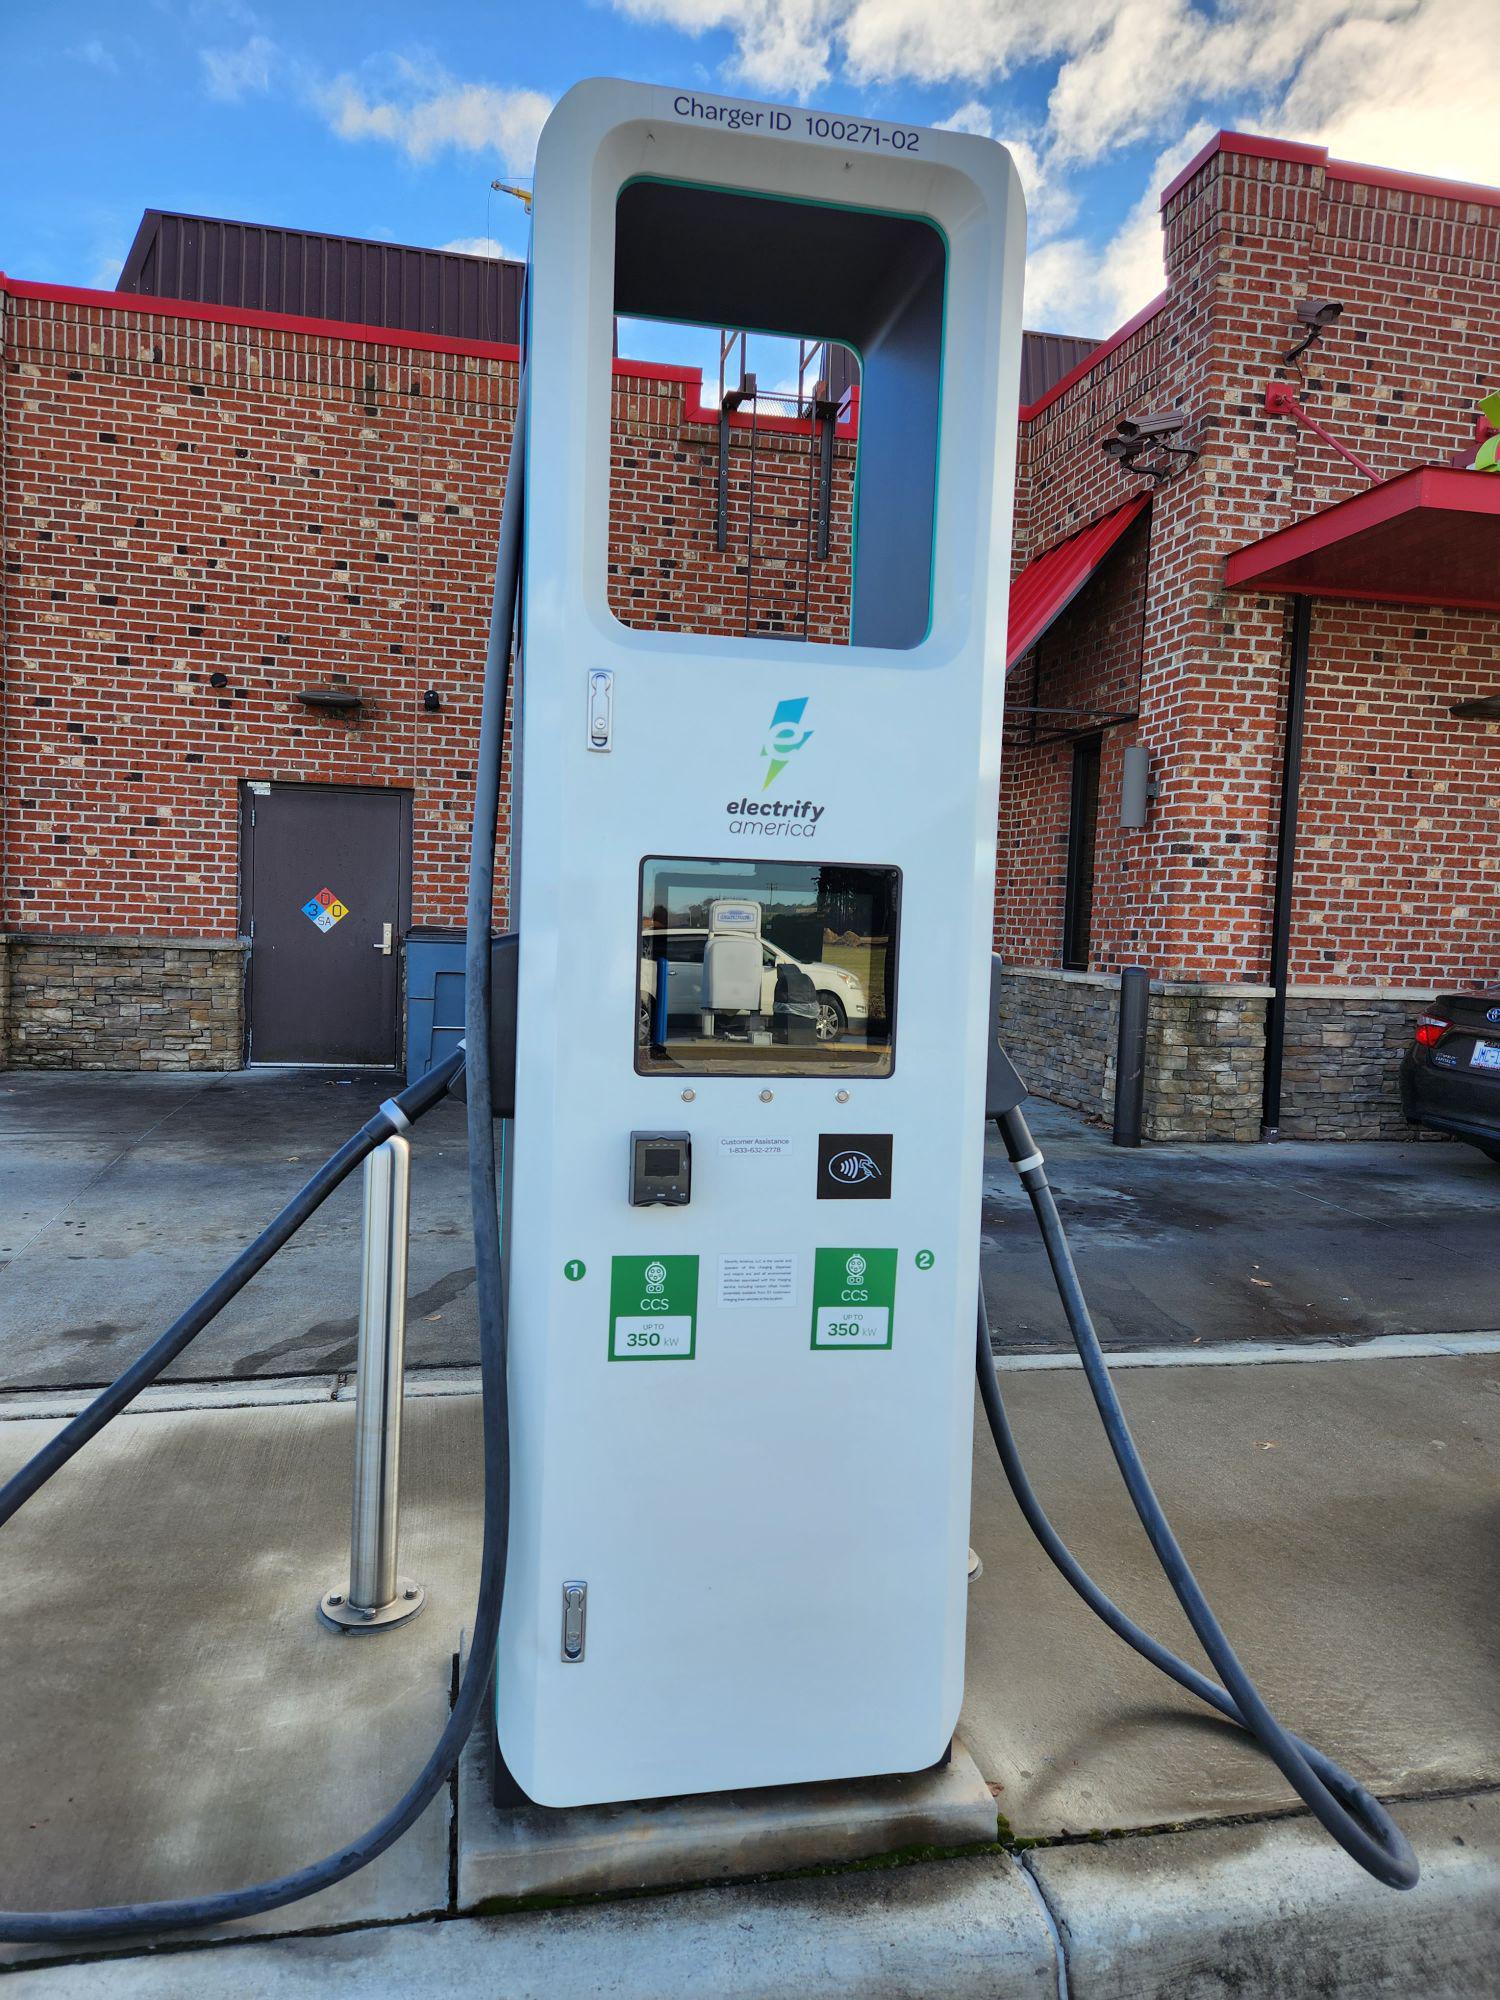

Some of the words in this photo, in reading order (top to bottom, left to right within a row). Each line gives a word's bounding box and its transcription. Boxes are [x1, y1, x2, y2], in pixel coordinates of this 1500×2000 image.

[673, 96, 764, 129] Charger
[770, 111, 792, 131] ID
[806, 117, 919, 151] 100271-02
[726, 798, 825, 823] electrify
[729, 820, 816, 837] america
[308, 904, 318, 916] 3
[919, 1252, 930, 1268] 2
[570, 1263, 579, 1278] 1
[841, 1289, 869, 1302] CCS
[640, 1298, 669, 1311] CCS
[827, 1322, 860, 1336] 350
[862, 1327, 878, 1336] kW
[626, 1333, 660, 1347] 350
[664, 1338, 680, 1346] kW
